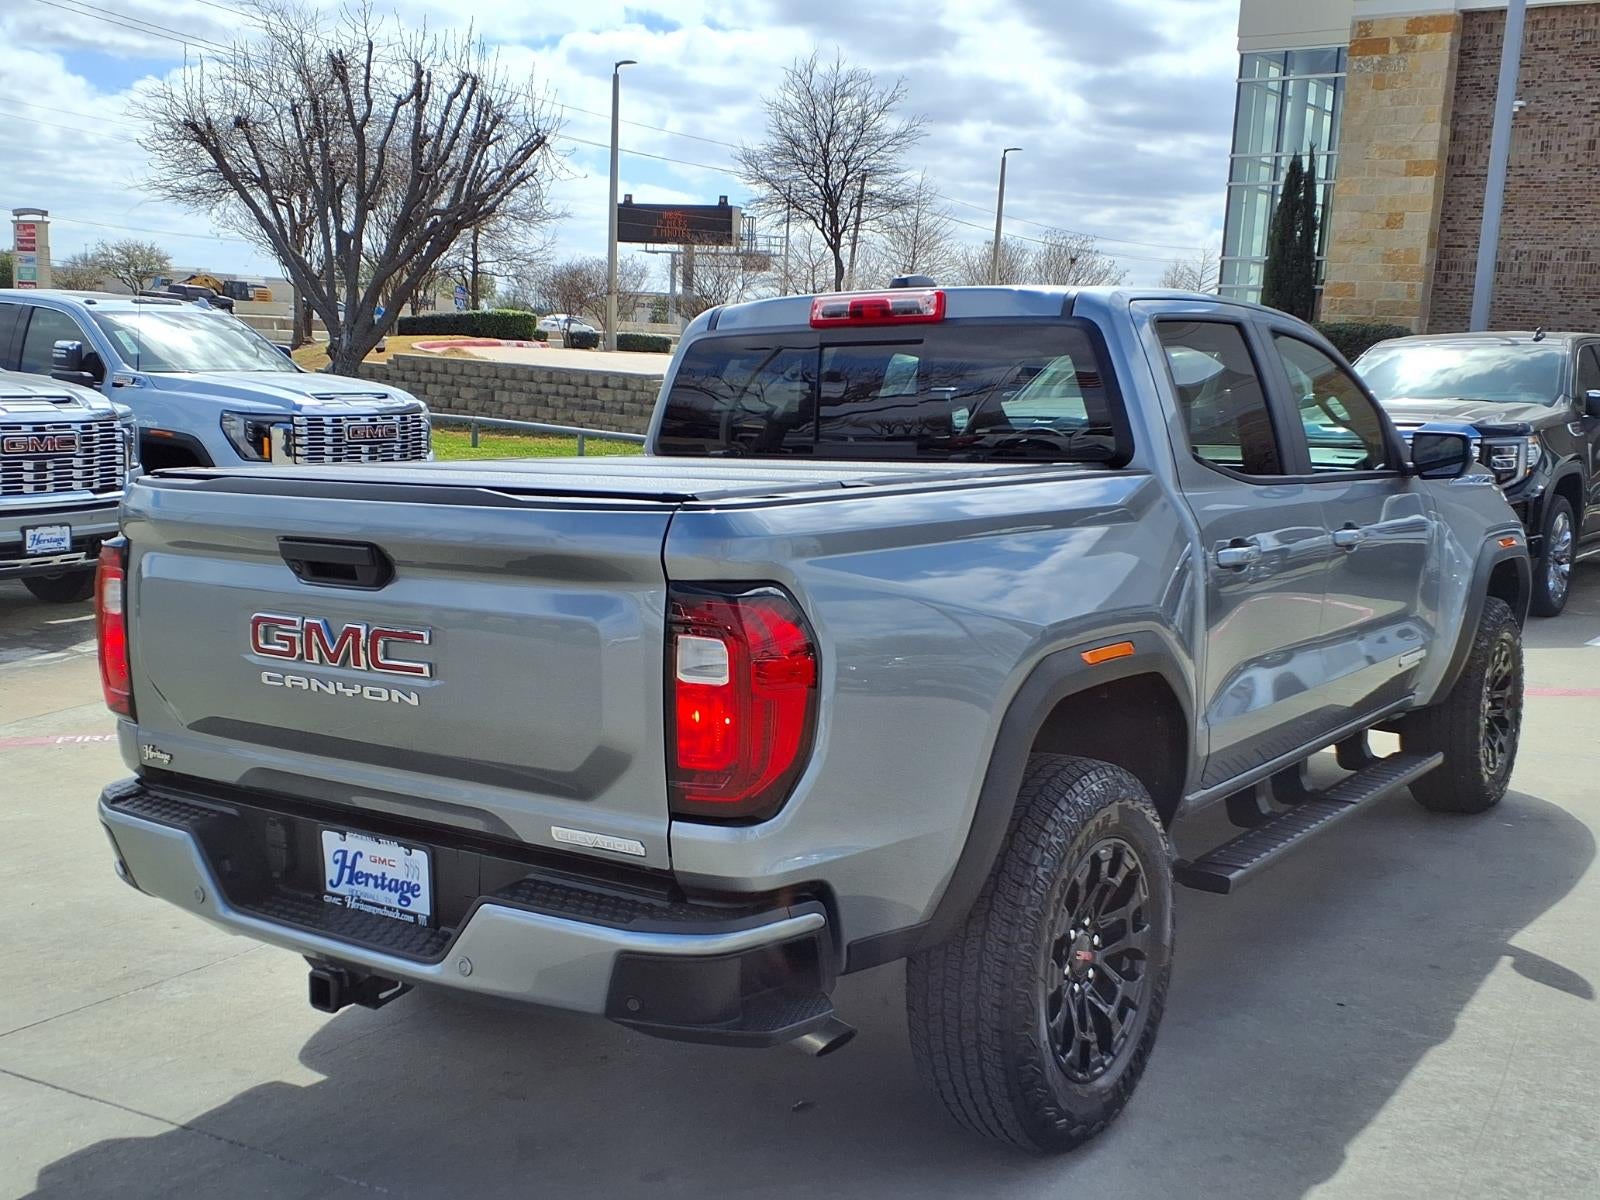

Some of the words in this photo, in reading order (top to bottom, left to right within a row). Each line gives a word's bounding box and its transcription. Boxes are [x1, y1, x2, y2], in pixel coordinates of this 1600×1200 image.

[350, 425, 397, 438] GMC
[4, 435, 77, 452] GMC
[250, 612, 431, 678] GMC
[261, 671, 420, 706] CANYON
[558, 829, 639, 854] ELEVATION
[368, 855, 396, 868] GMC
[329, 849, 421, 907] Heritage
[323, 895, 343, 906] GMC
